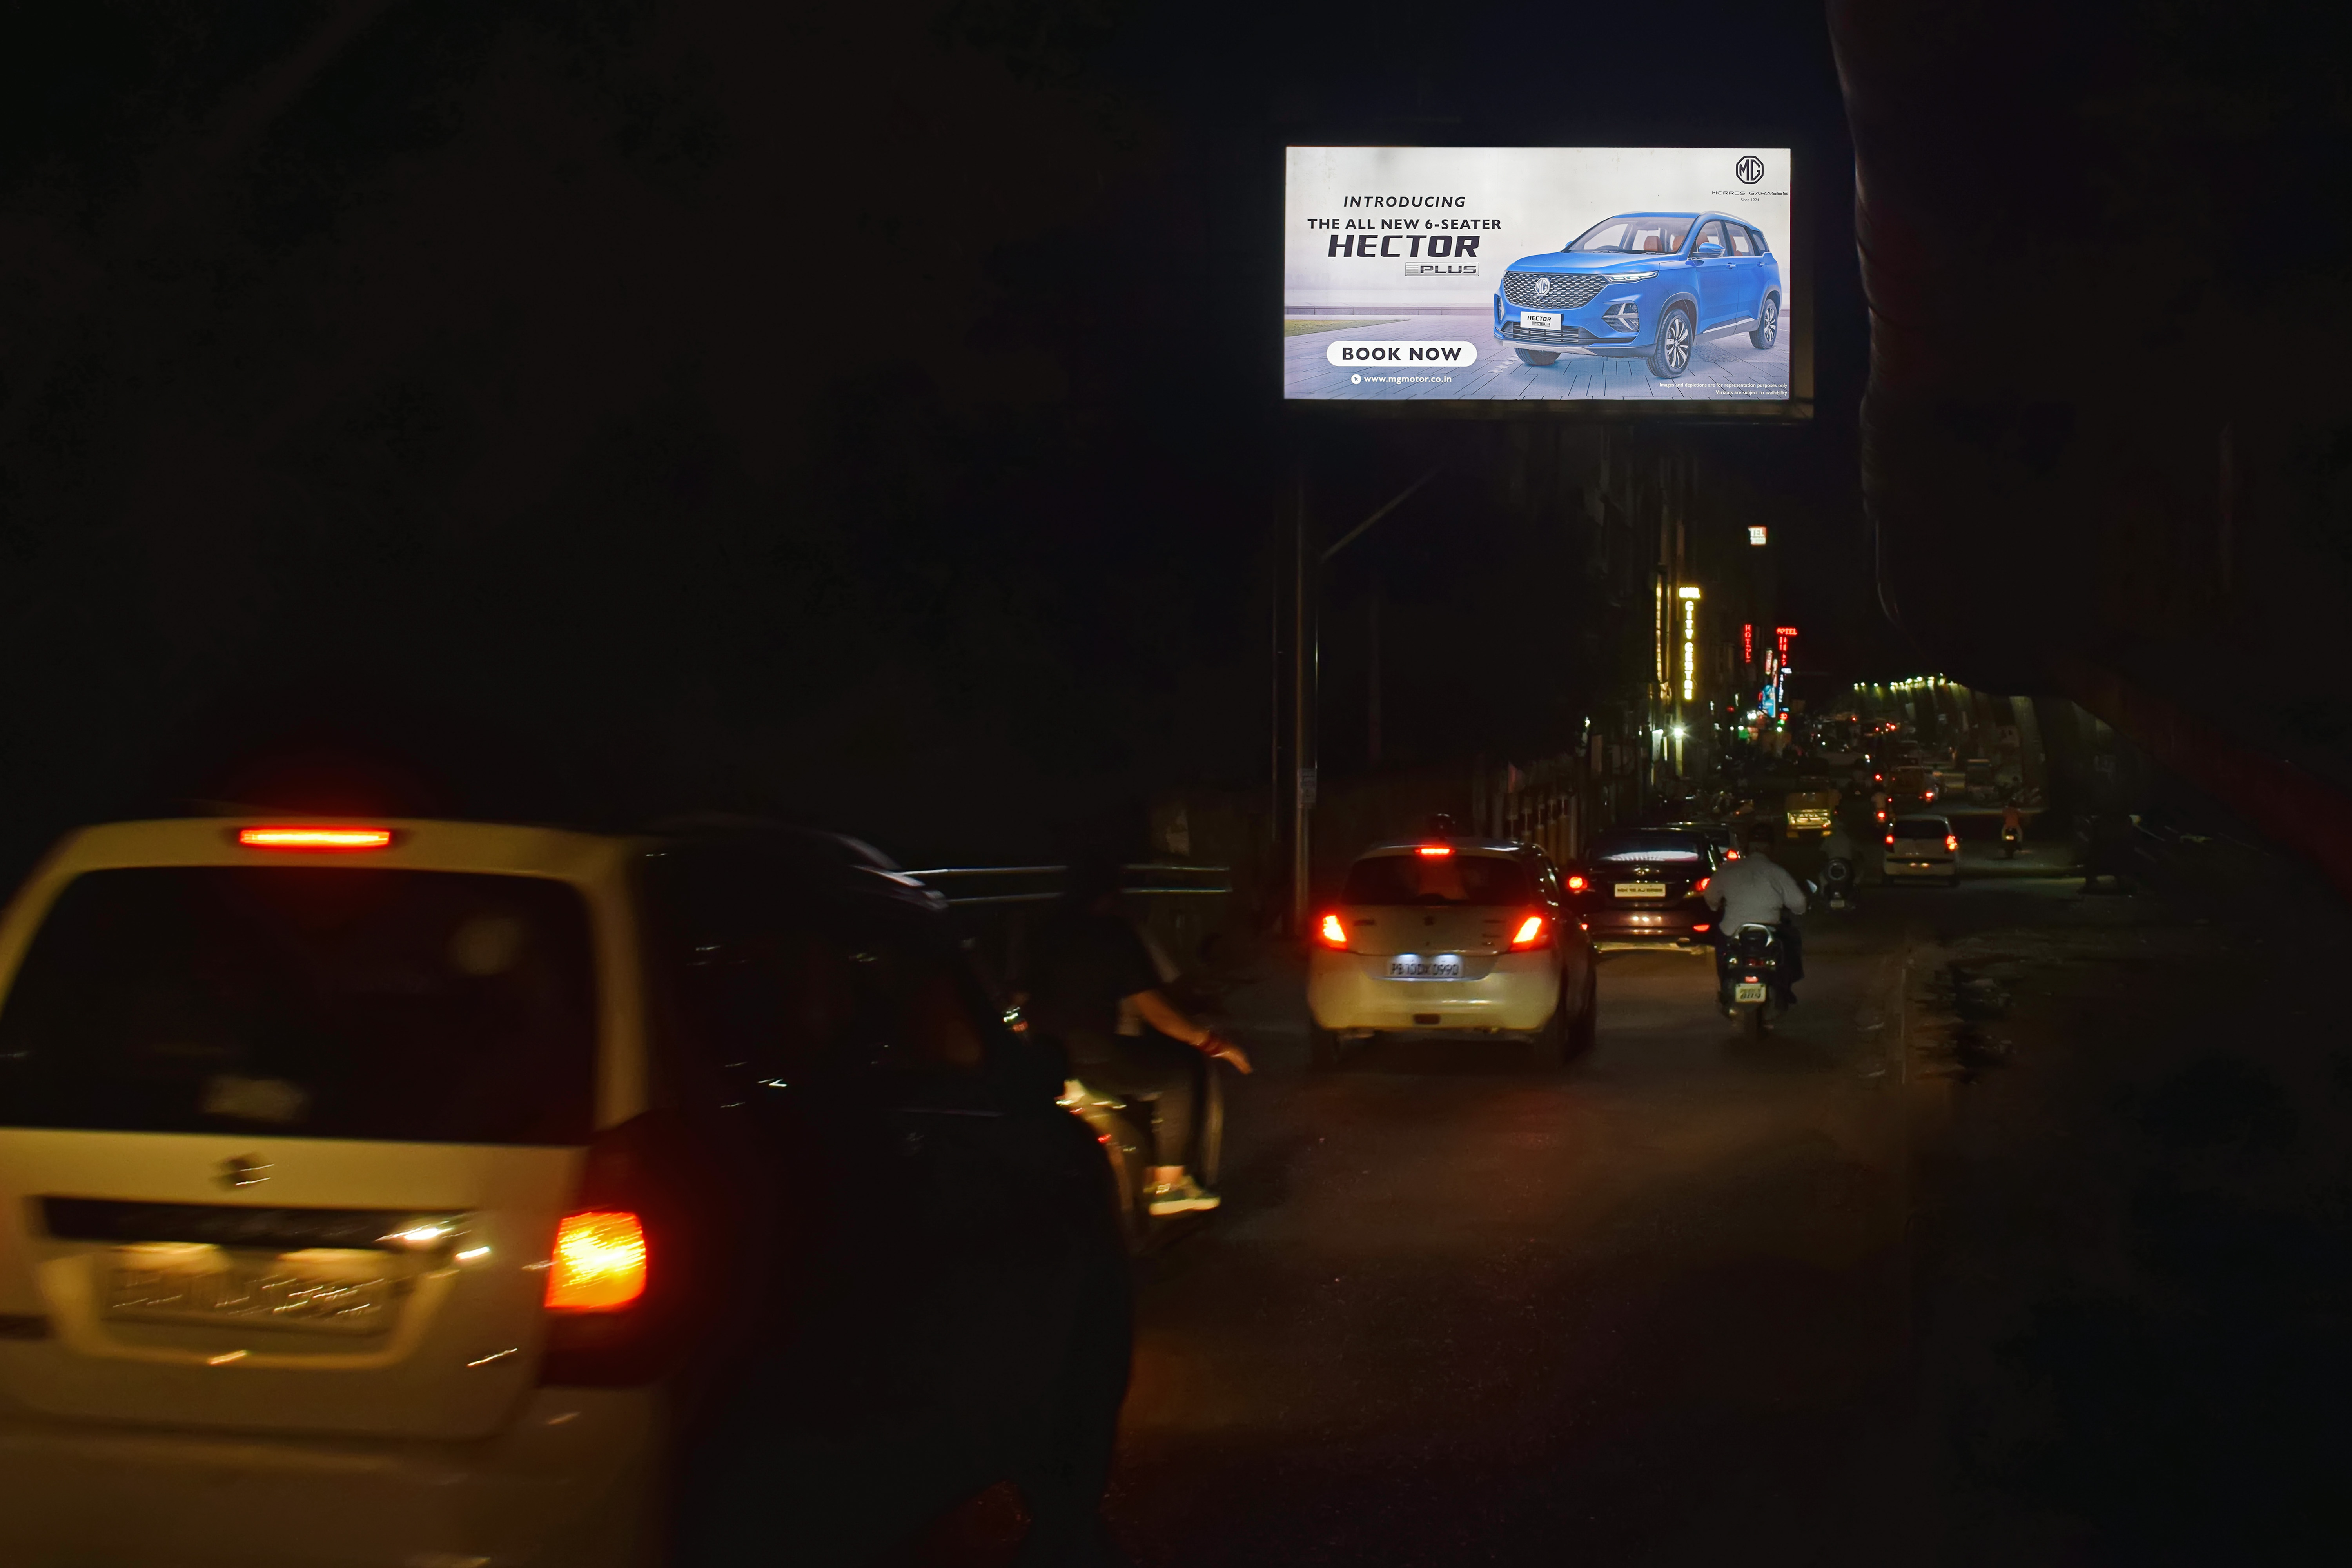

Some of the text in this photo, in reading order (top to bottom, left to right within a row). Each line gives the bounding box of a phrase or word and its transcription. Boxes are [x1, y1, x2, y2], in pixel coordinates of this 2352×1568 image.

[1739, 159, 1761, 181] MG
[1344, 196, 1465, 207] INTRODUCING
[1307, 218, 1501, 230] THE ALL NEW 6-SEATER
[1328, 234, 1480, 257] HECTOR
[1420, 265, 1477, 274] PLUS
[1343, 347, 1462, 361] BOOK NOW
[1364, 375, 1452, 384] www.mgmotor.co.in
